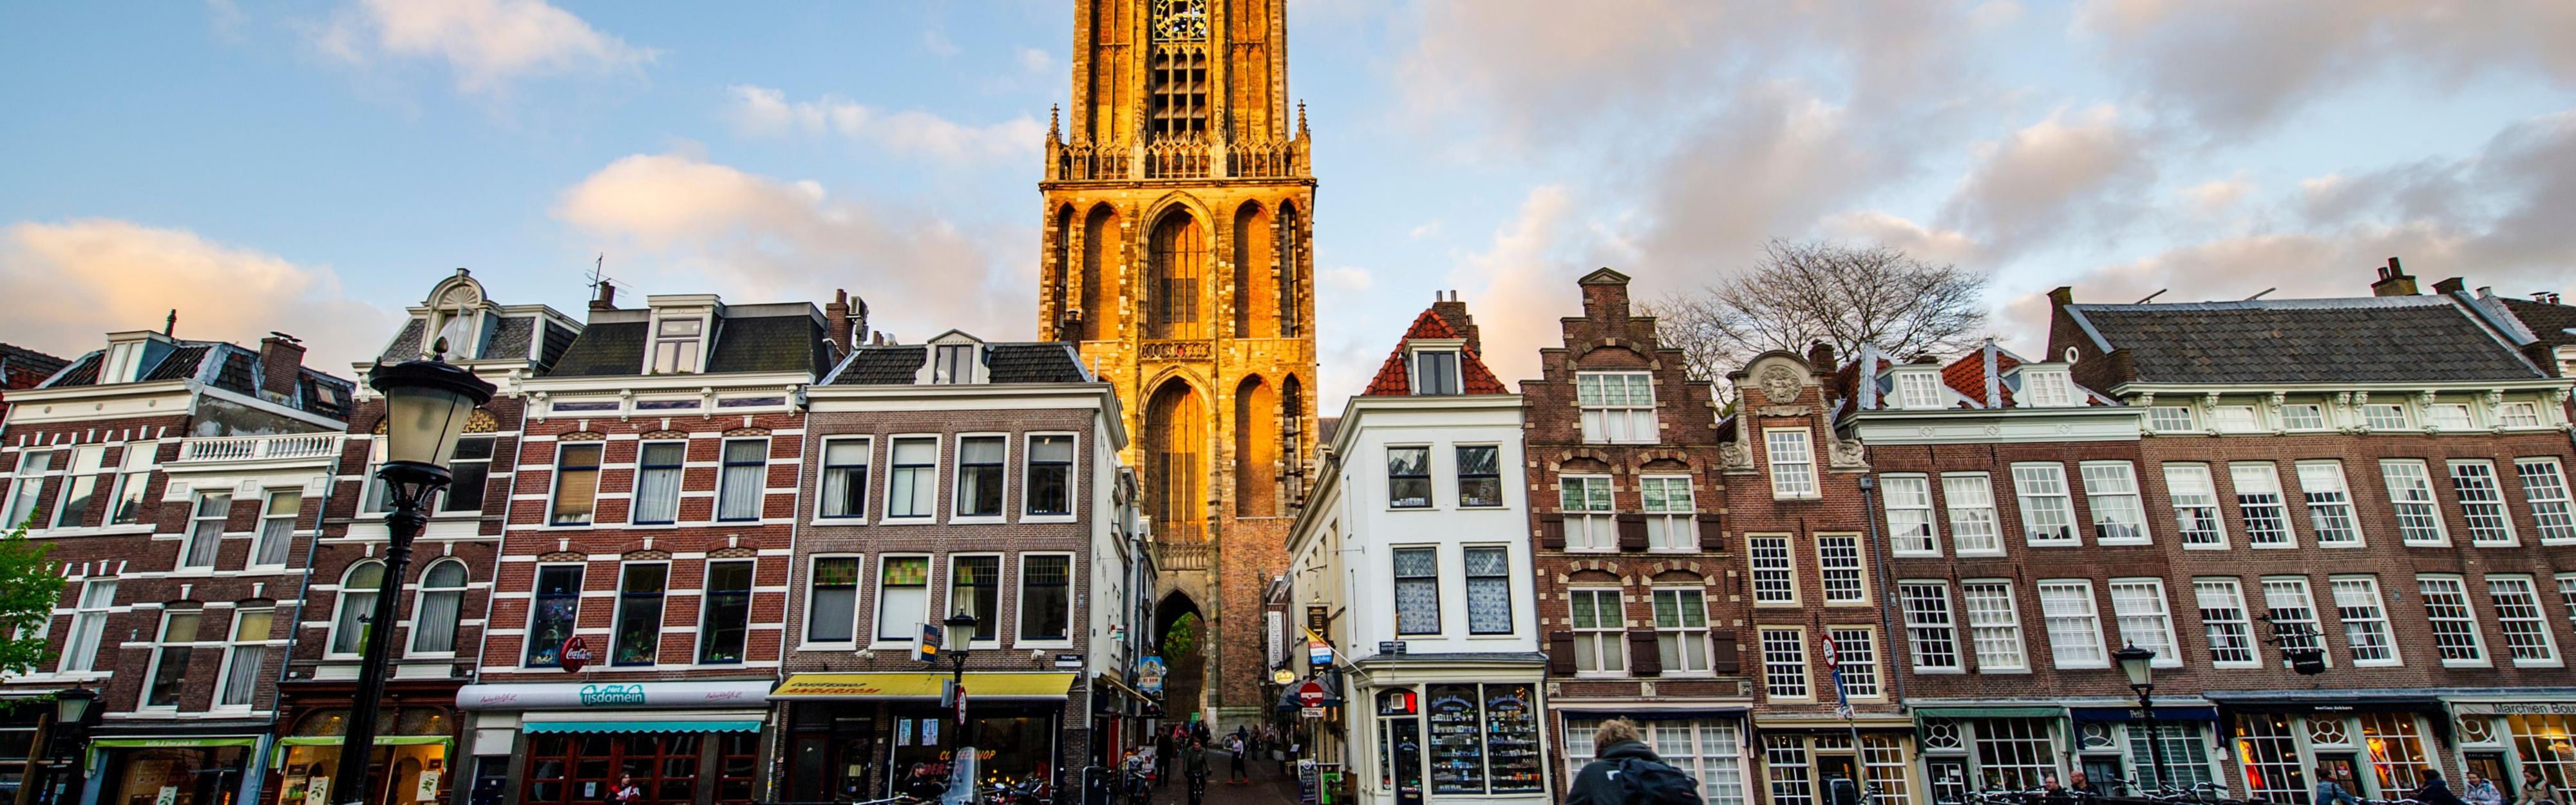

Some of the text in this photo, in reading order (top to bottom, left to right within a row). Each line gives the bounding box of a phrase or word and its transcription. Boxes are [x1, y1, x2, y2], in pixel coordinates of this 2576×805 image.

[583, 690, 643, 705] ijsdomein
[2492, 702, 2576, 714] Marchien Bou
